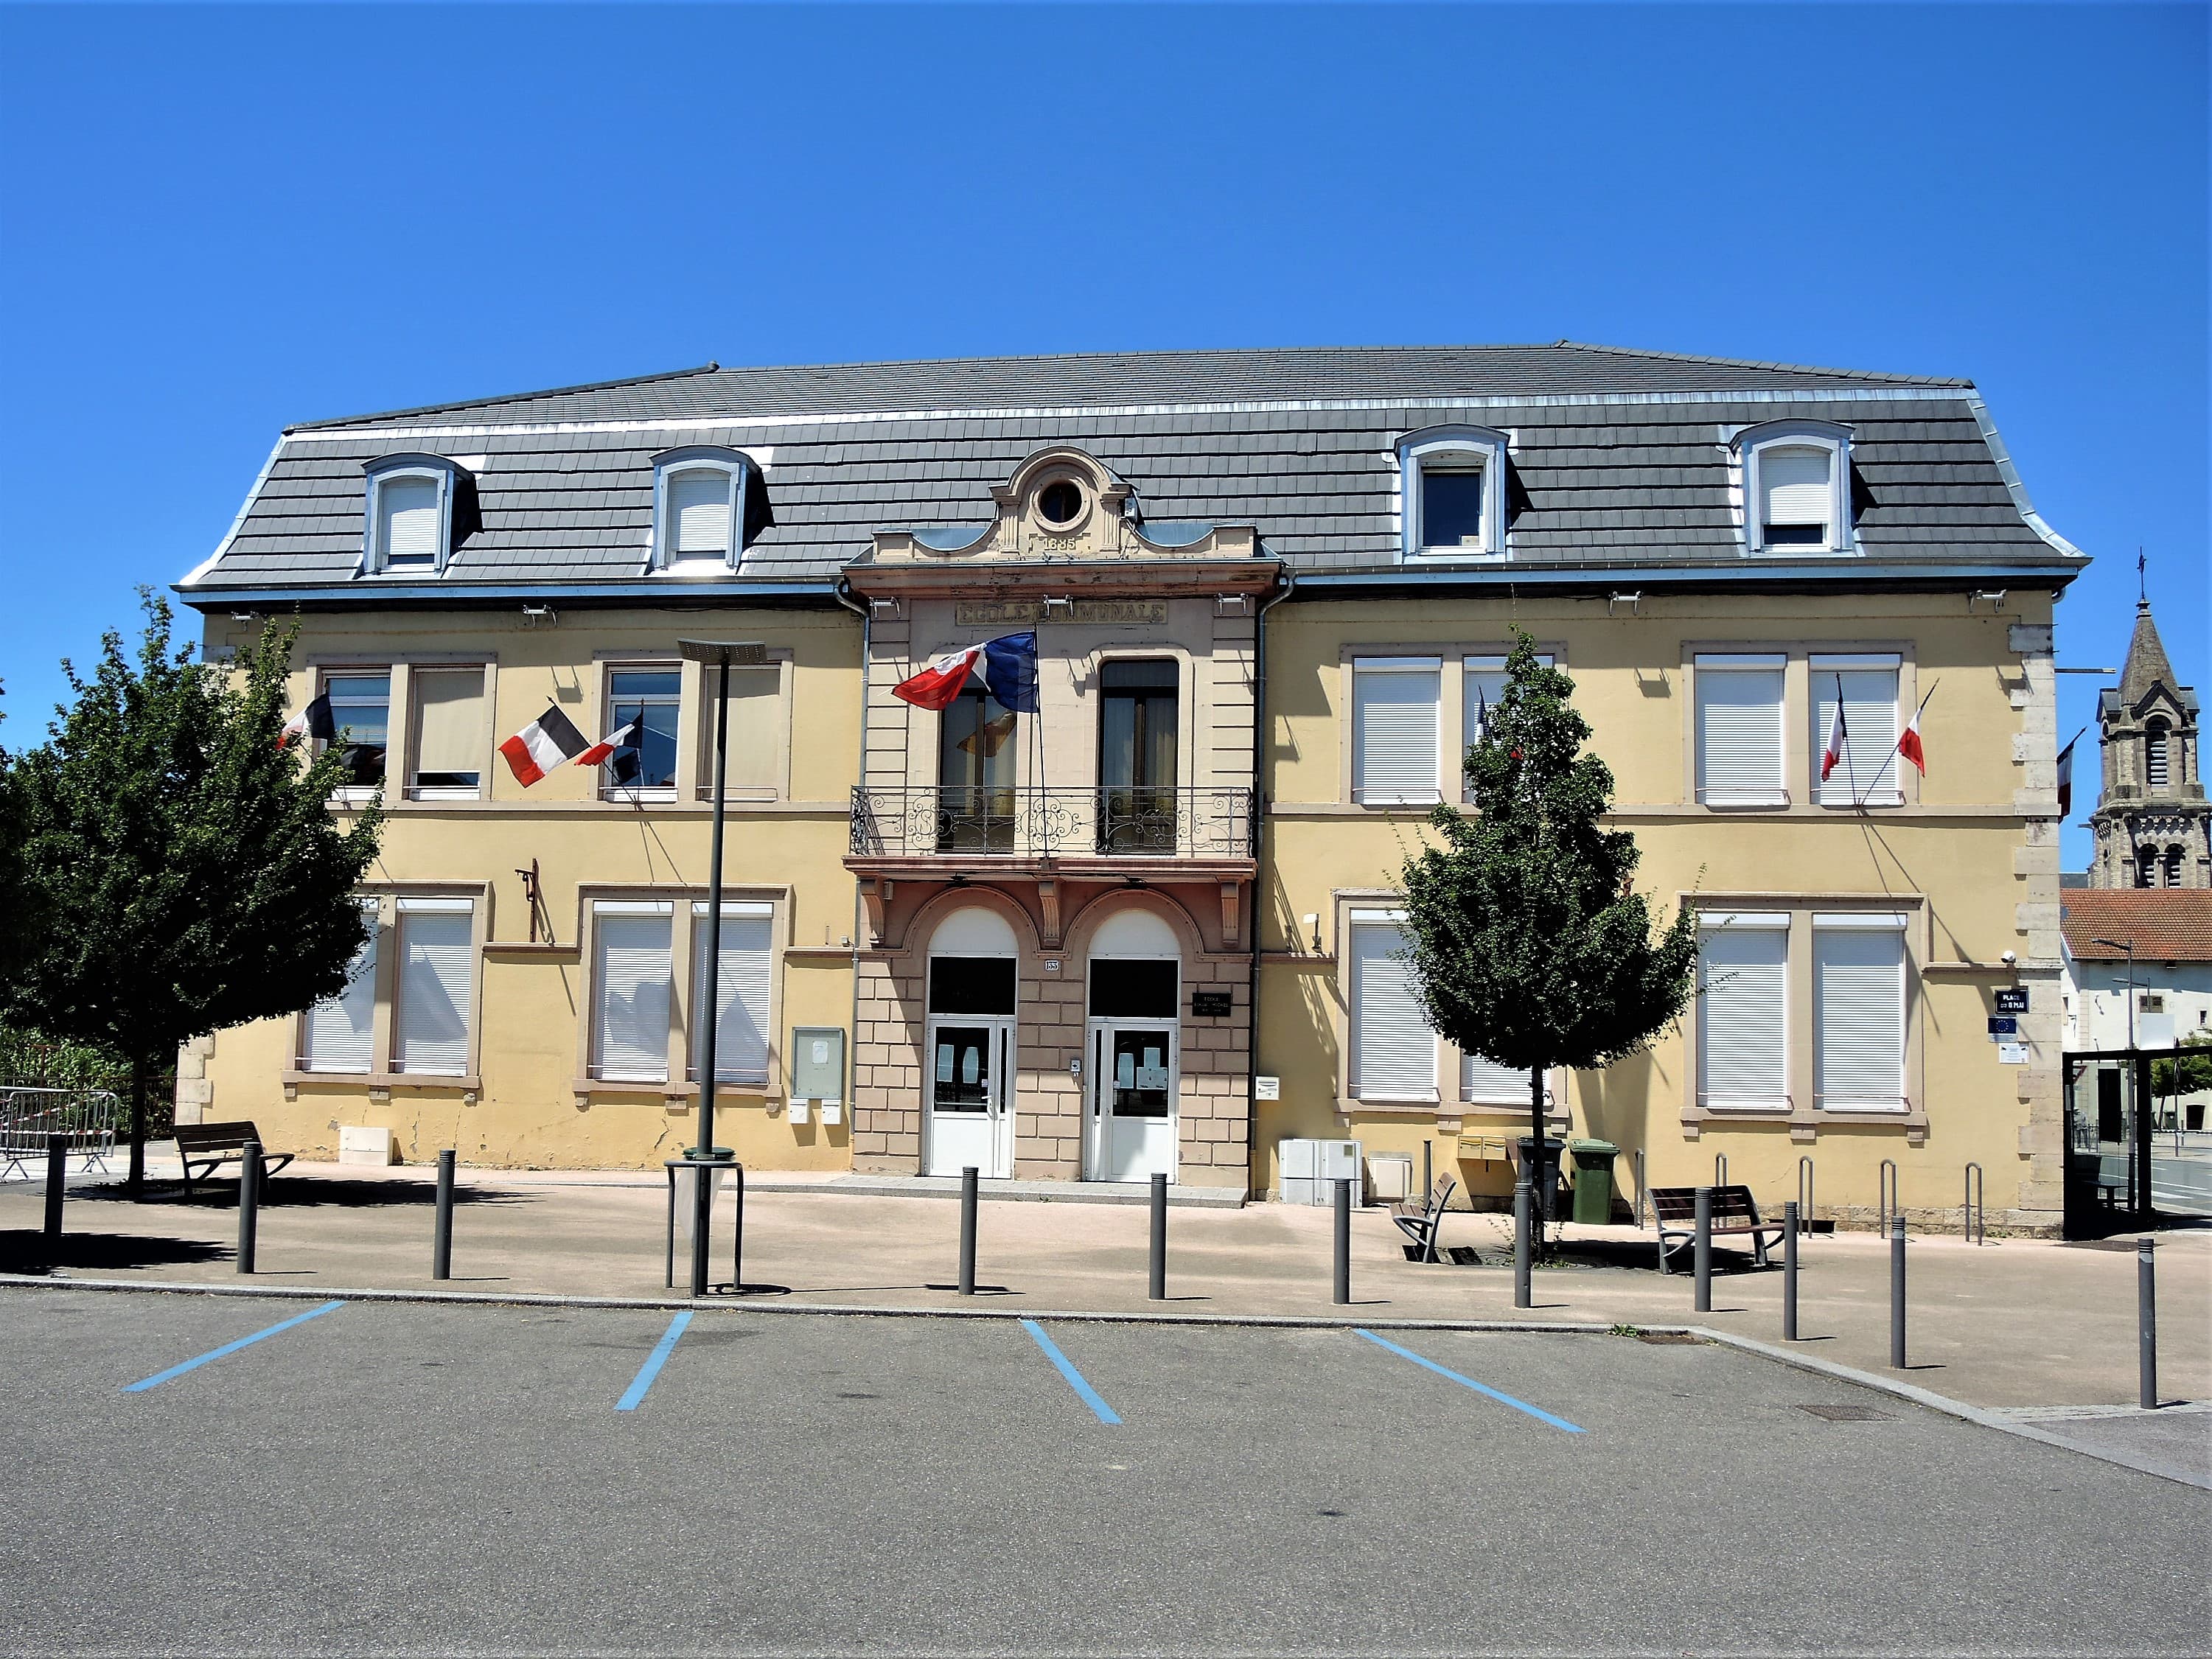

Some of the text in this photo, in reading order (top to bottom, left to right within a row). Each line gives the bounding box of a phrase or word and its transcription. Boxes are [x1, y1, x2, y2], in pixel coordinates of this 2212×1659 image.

[1044, 538, 1076, 551] 1885
[960, 602, 1165, 622] ECOLE COMMUNALE
